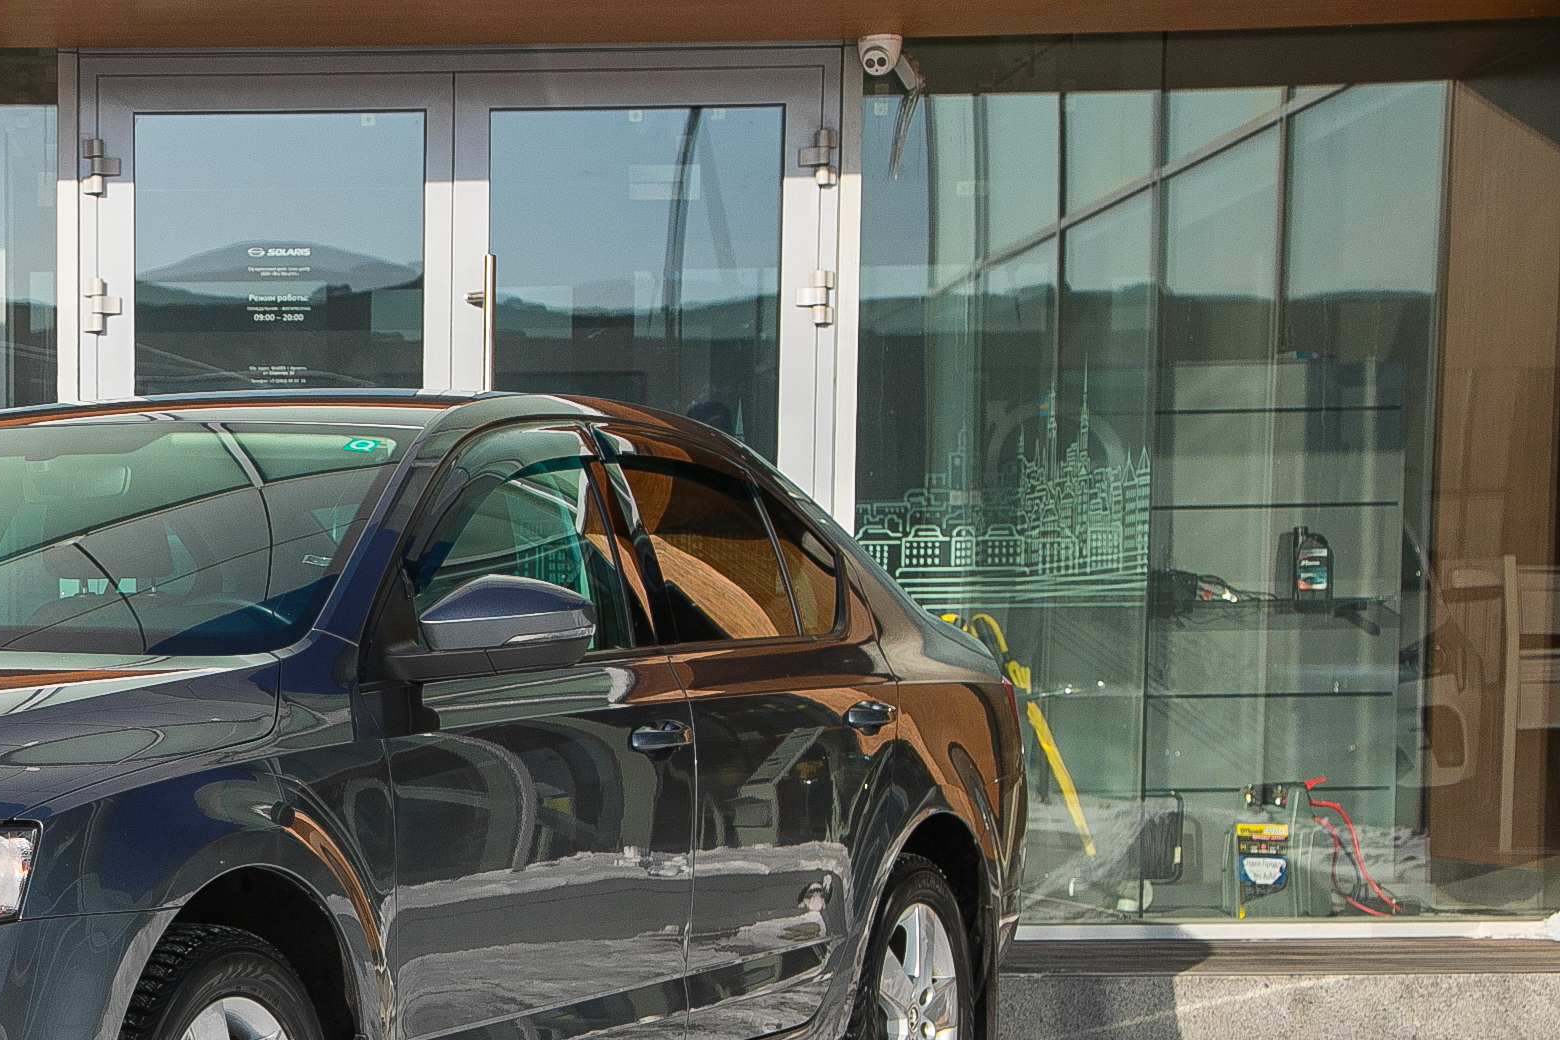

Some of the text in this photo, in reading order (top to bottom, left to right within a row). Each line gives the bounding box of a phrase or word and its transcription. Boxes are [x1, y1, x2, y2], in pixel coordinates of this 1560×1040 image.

[267, 248, 311, 257] SOLARIS
[254, 313, 275, 321] 09:00
[282, 313, 304, 321] 20:00
